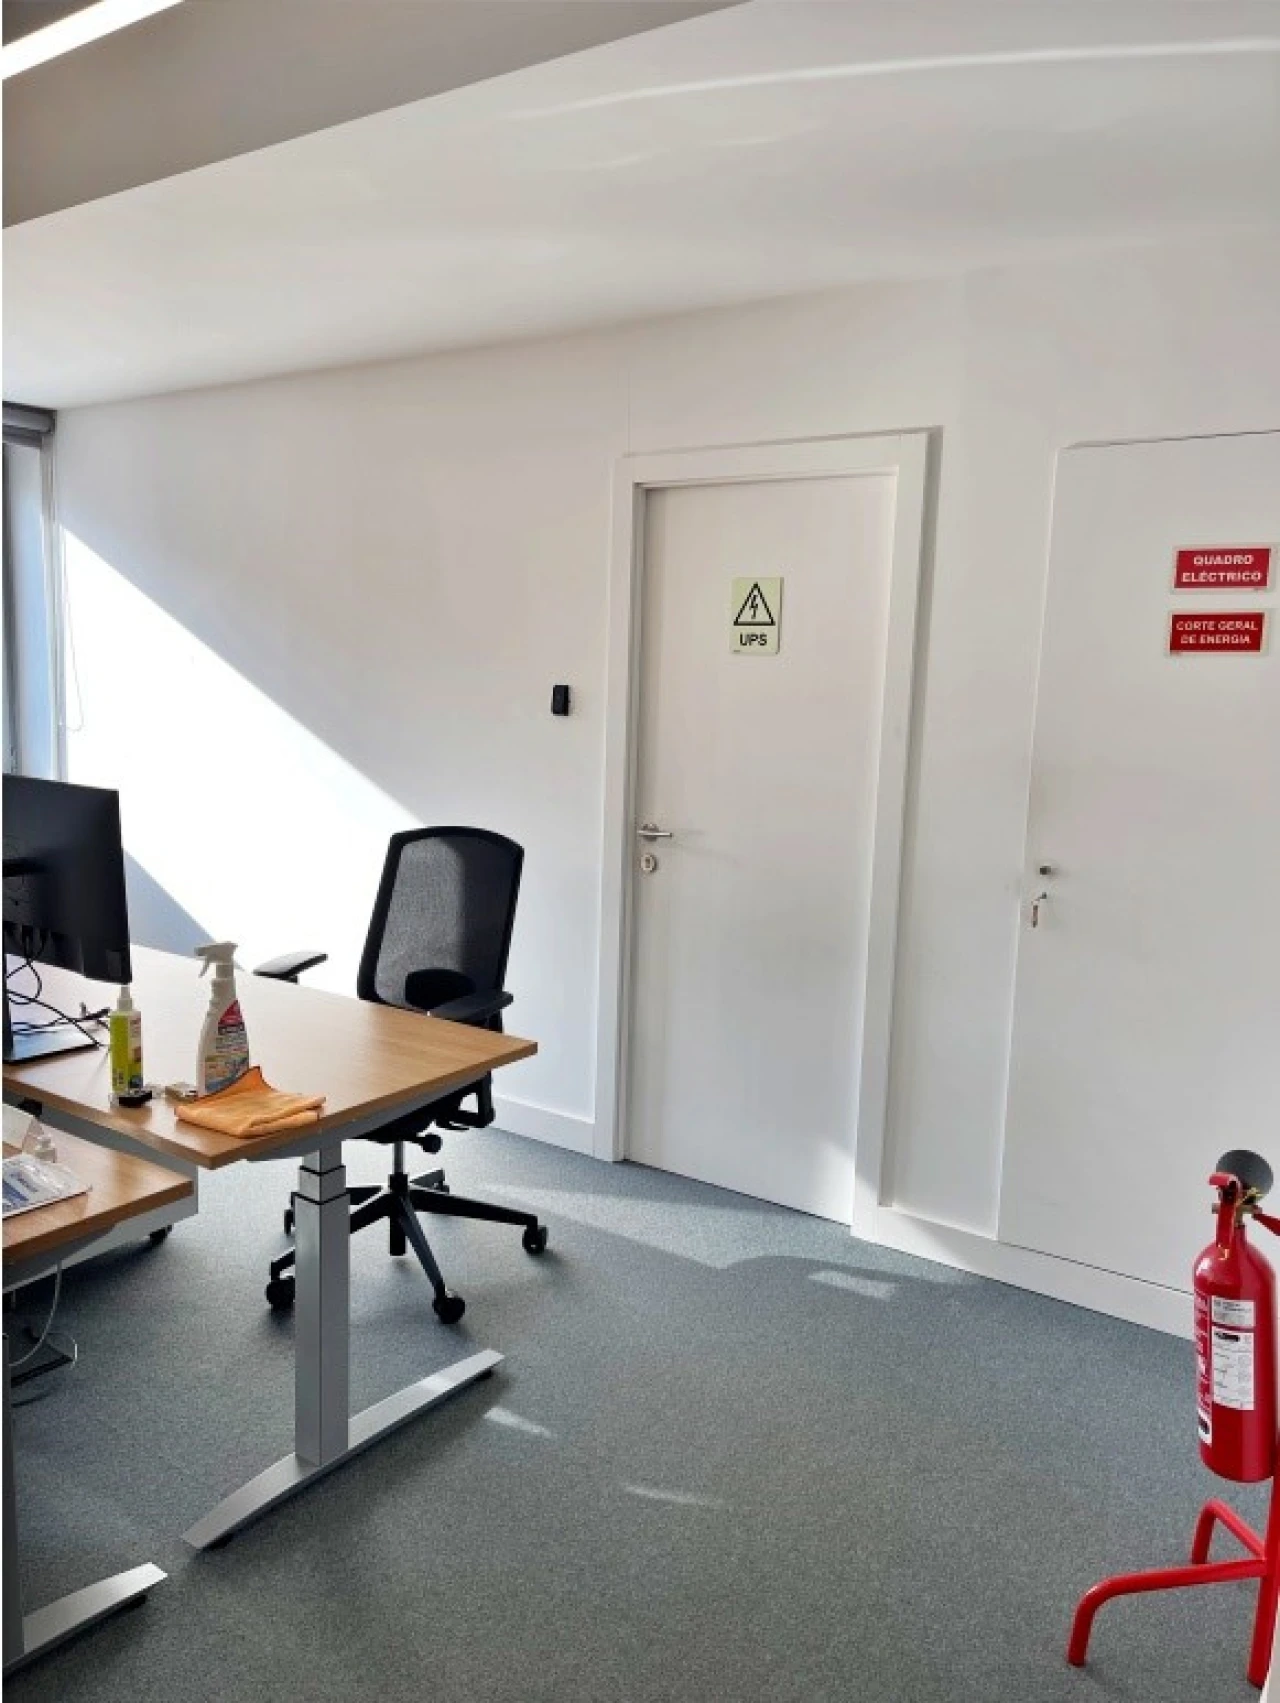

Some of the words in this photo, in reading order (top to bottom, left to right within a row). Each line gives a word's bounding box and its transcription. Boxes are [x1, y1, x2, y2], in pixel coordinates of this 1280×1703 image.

[1193, 554, 1254, 566] QUADRO
[1181, 571, 1262, 582] ELÉCTRICO
[1176, 620, 1216, 631] CORTE
[1217, 620, 1258, 631] GERAL
[739, 632, 767, 646] UPS
[1180, 634, 1197, 644] DE
[1200, 634, 1251, 644] ENERGIA
